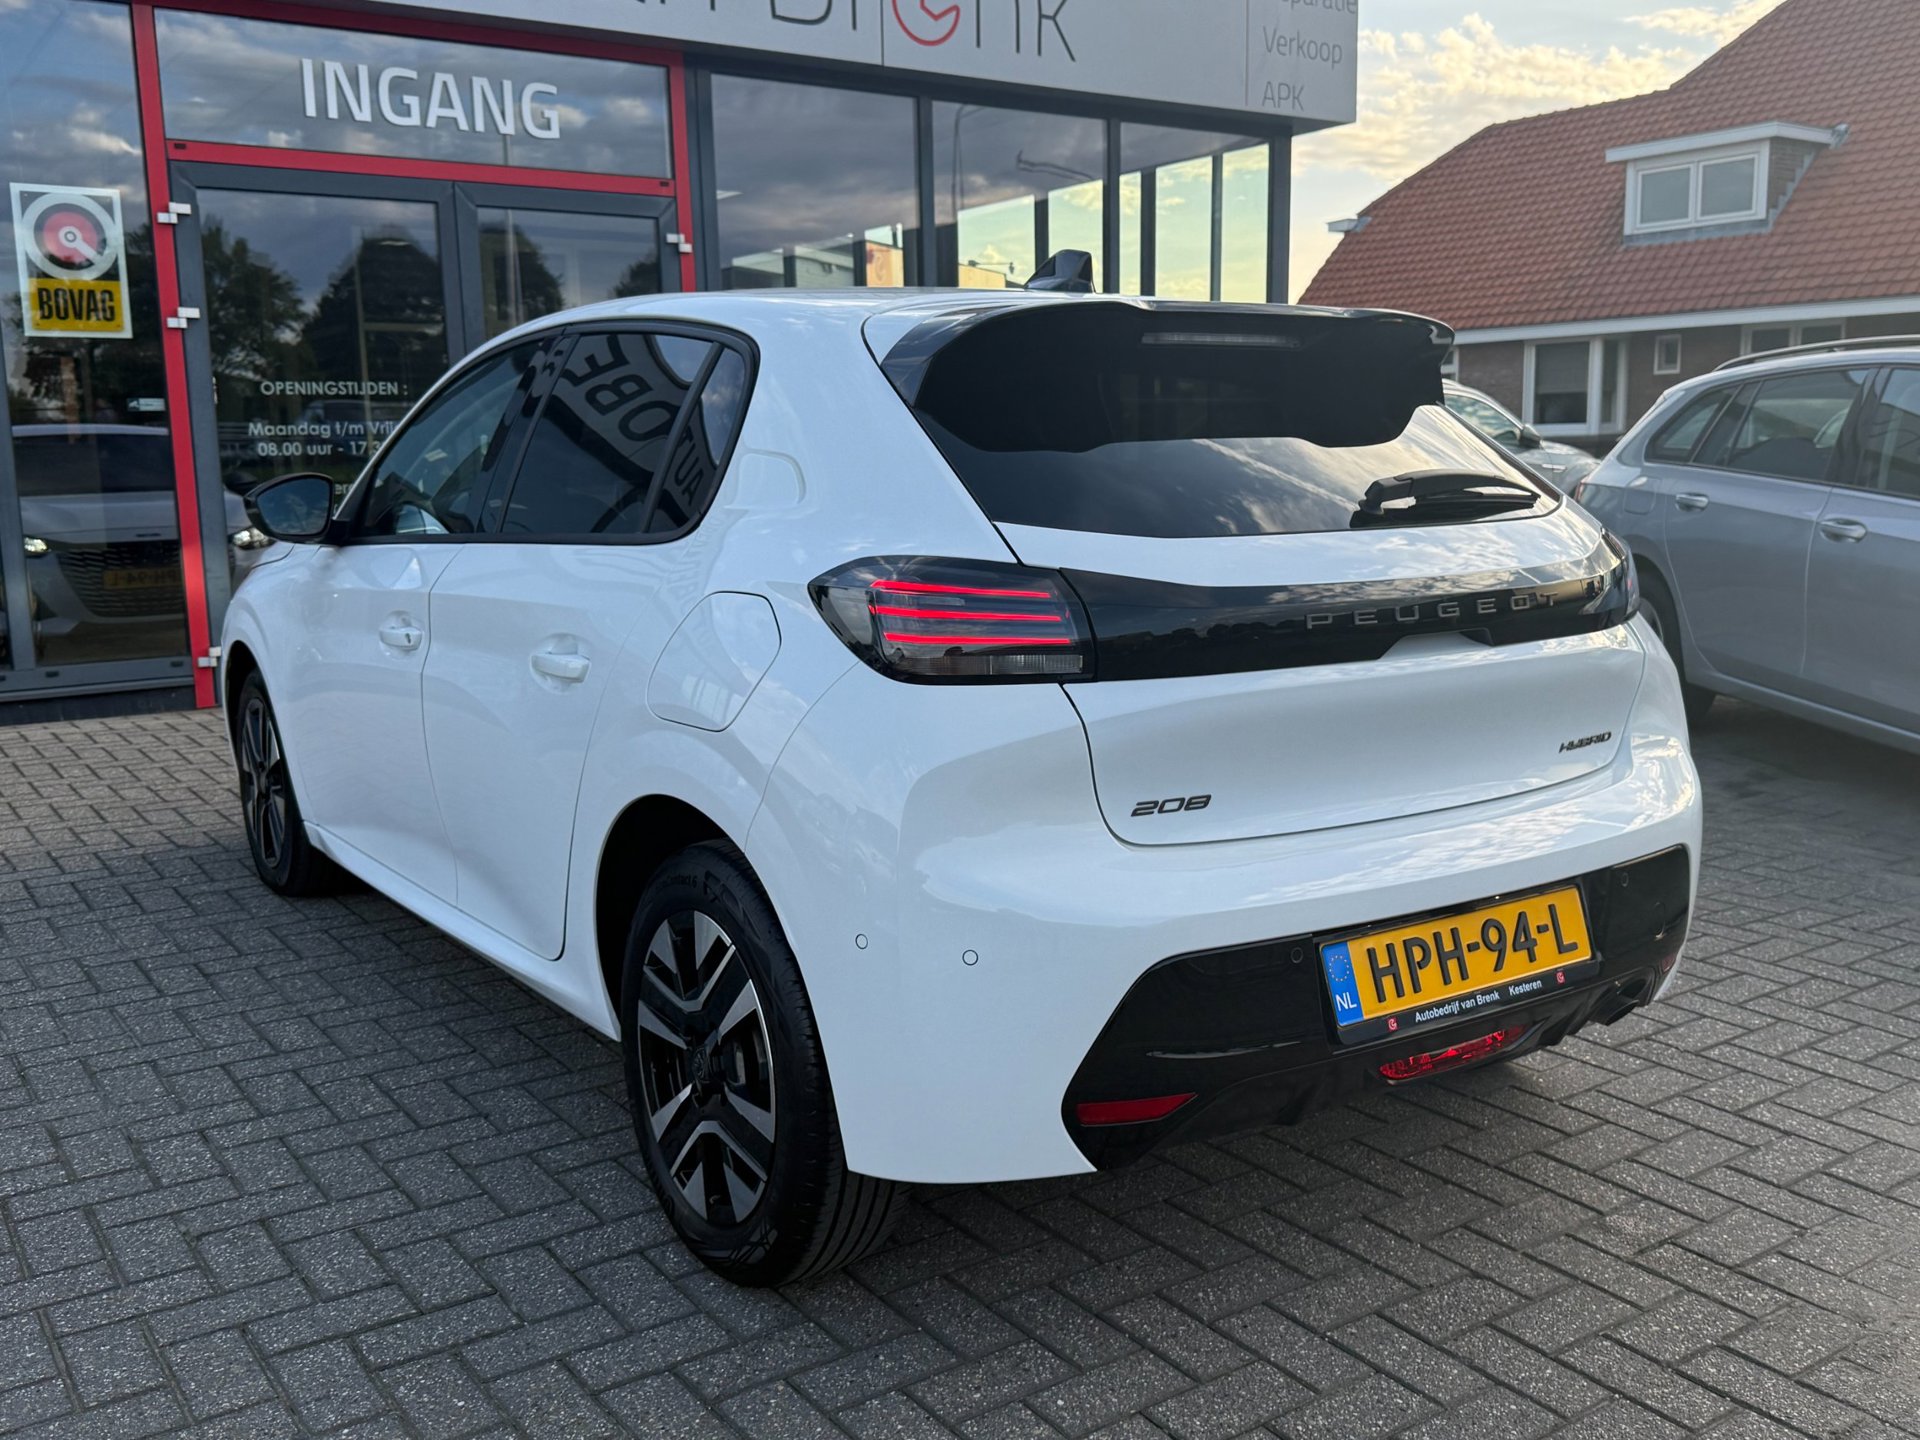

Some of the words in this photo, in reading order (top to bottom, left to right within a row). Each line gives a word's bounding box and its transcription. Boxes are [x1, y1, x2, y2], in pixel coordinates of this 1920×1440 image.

[1262, 26, 1343, 71] Verkoop
[301, 58, 562, 140] INGANG
[1262, 81, 1304, 112] APK
[37, 287, 116, 322] BOVAG
[260, 381, 398, 396] OPENINGSTIJDEN
[248, 422, 331, 438] Maandag
[334, 421, 364, 436] t/m
[258, 442, 301, 457] 08.00
[307, 444, 333, 456] uur
[1306, 591, 1560, 630] PEUGEOT
[1558, 731, 1612, 753] HYBRID
[1130, 793, 1212, 817] 208
[1366, 904, 1579, 1003] HPH-94-L
[1335, 993, 1358, 1012] NL
[1415, 1002, 1460, 1022] Autobedrijf
[1461, 998, 1476, 1009] van
[1477, 991, 1500, 1005] Brenk
[1508, 979, 1543, 996] Kesteren
